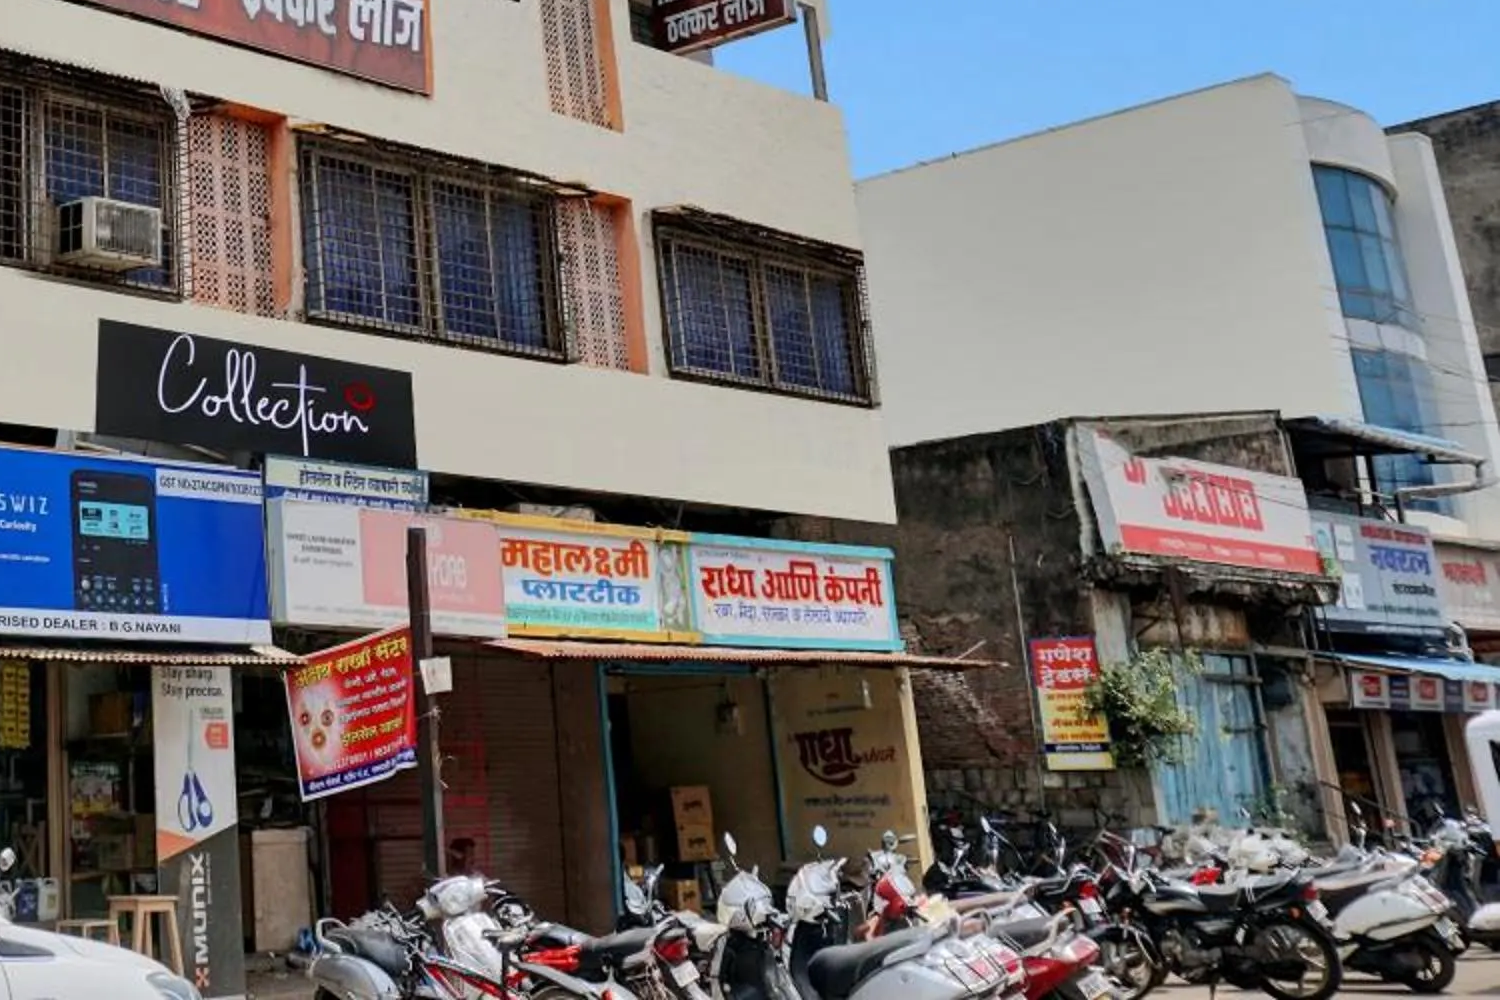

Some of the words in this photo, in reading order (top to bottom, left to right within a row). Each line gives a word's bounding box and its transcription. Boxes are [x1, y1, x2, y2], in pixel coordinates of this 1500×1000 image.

[664, 1, 719, 43] ठक्कर
[157, 333, 369, 457] Collection
[700, 563, 756, 598] राधा
[761, 560, 822, 602] आणि
[824, 565, 883, 606] कंपनी
[43, 616, 98, 631] DEALER
